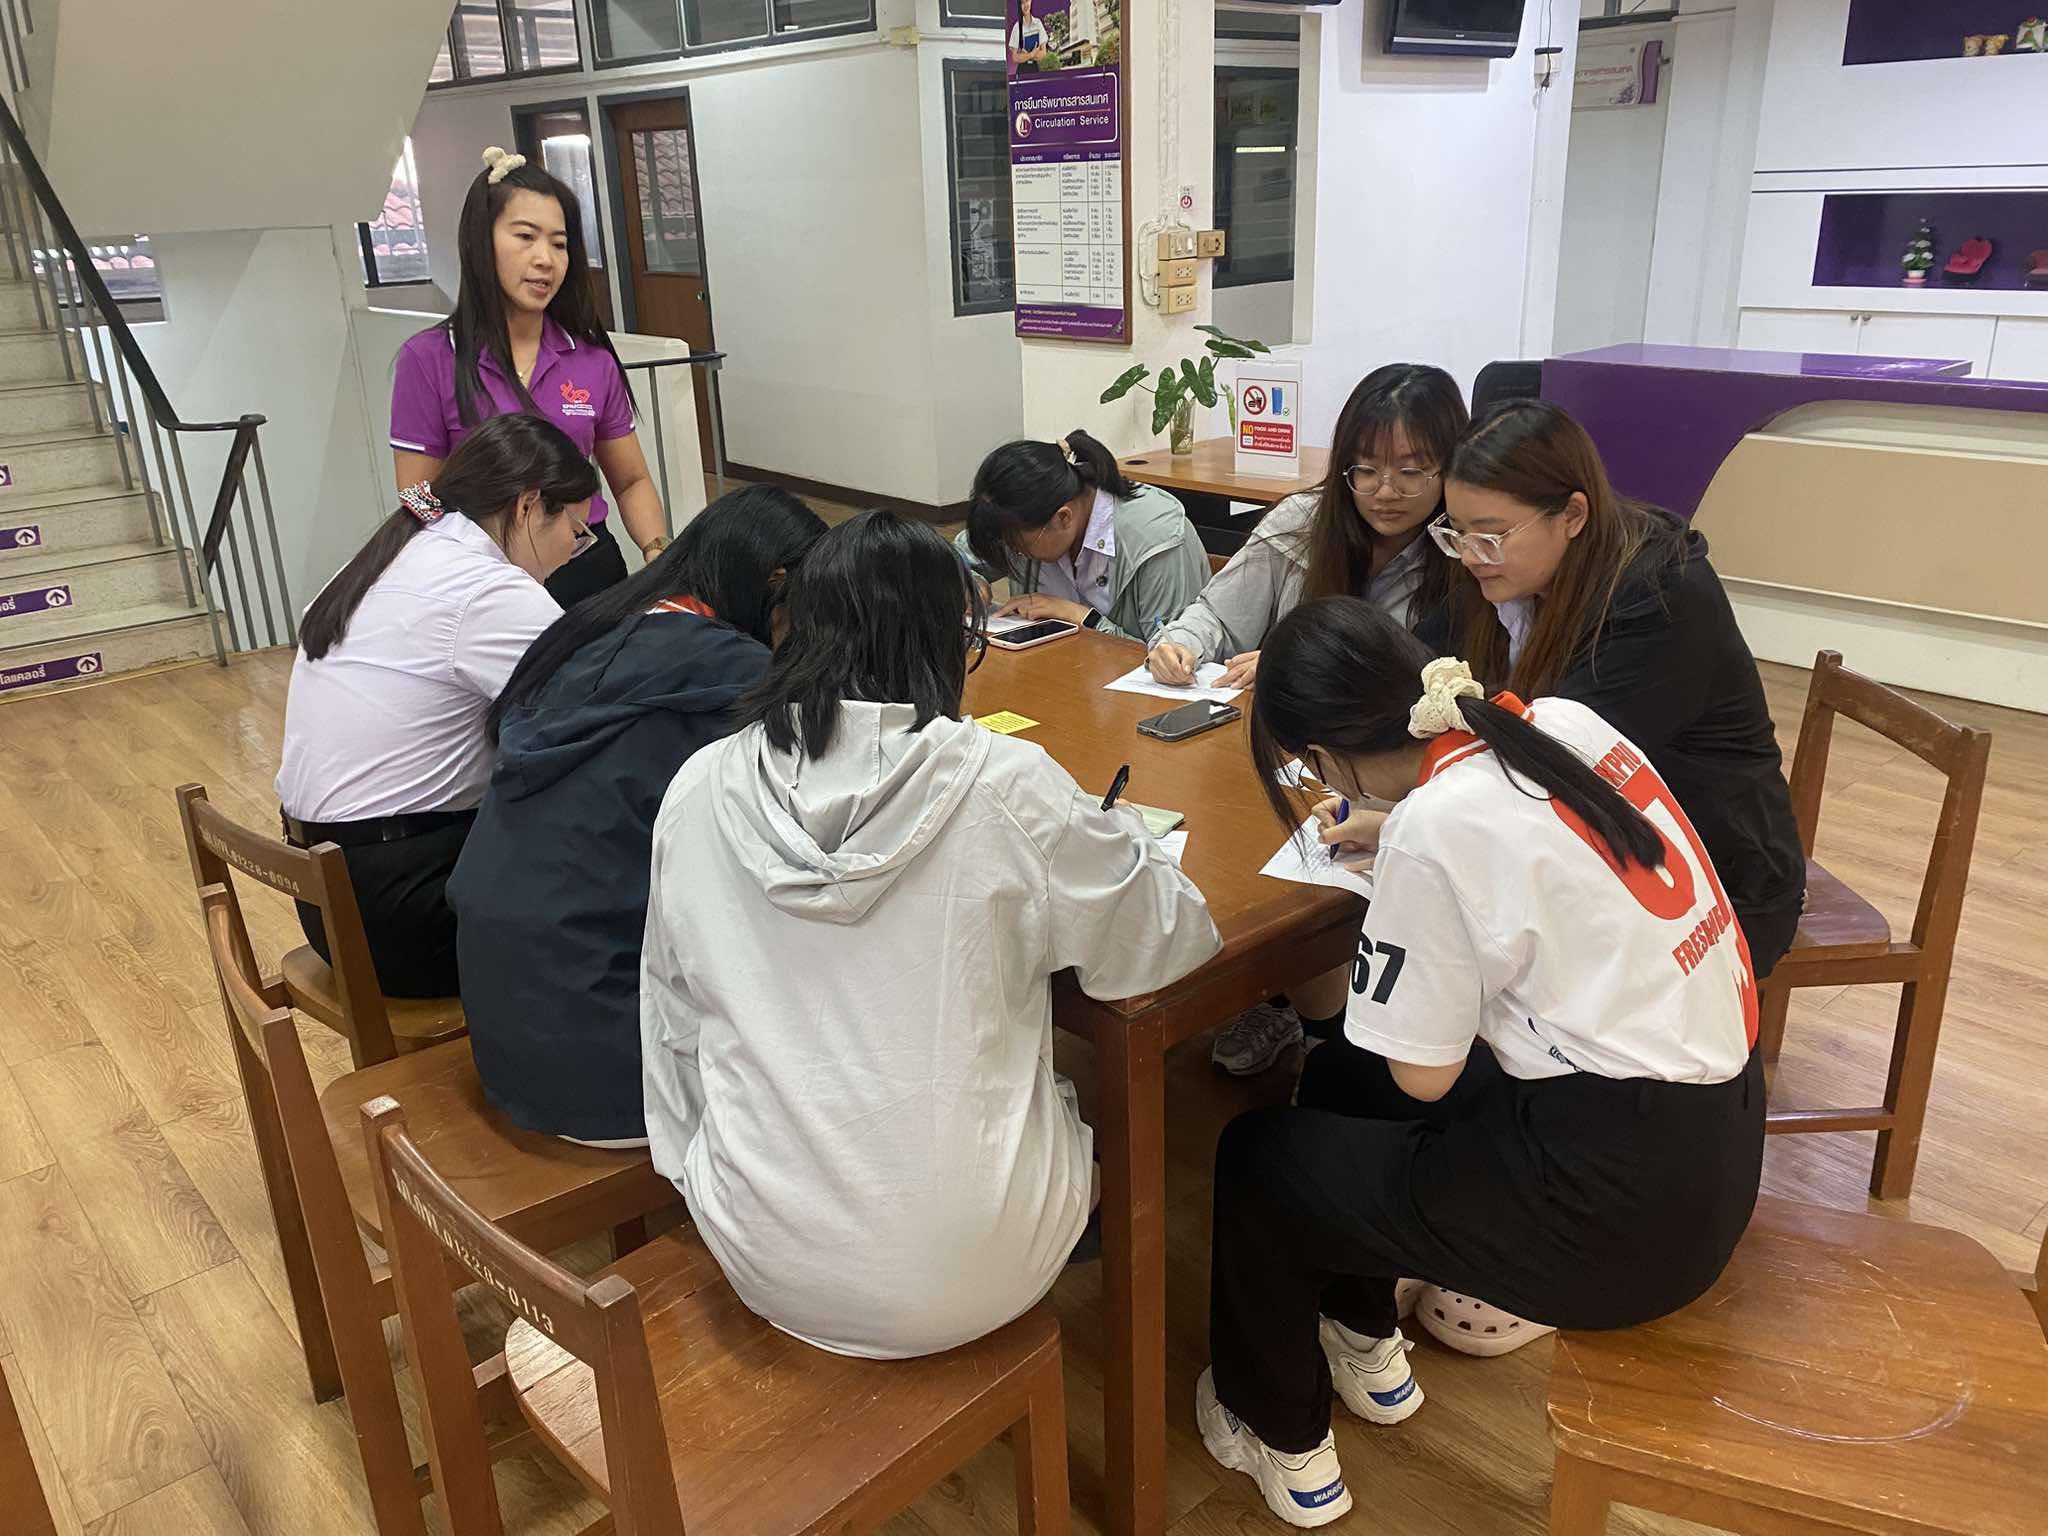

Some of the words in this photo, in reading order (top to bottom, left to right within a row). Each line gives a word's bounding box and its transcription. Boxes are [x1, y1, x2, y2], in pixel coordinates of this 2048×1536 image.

[1034, 117, 1076, 129] Circulation
[1079, 115, 1109, 126] Service
[1243, 424, 1254, 434] NO
[1351, 930, 1407, 1005] 67
